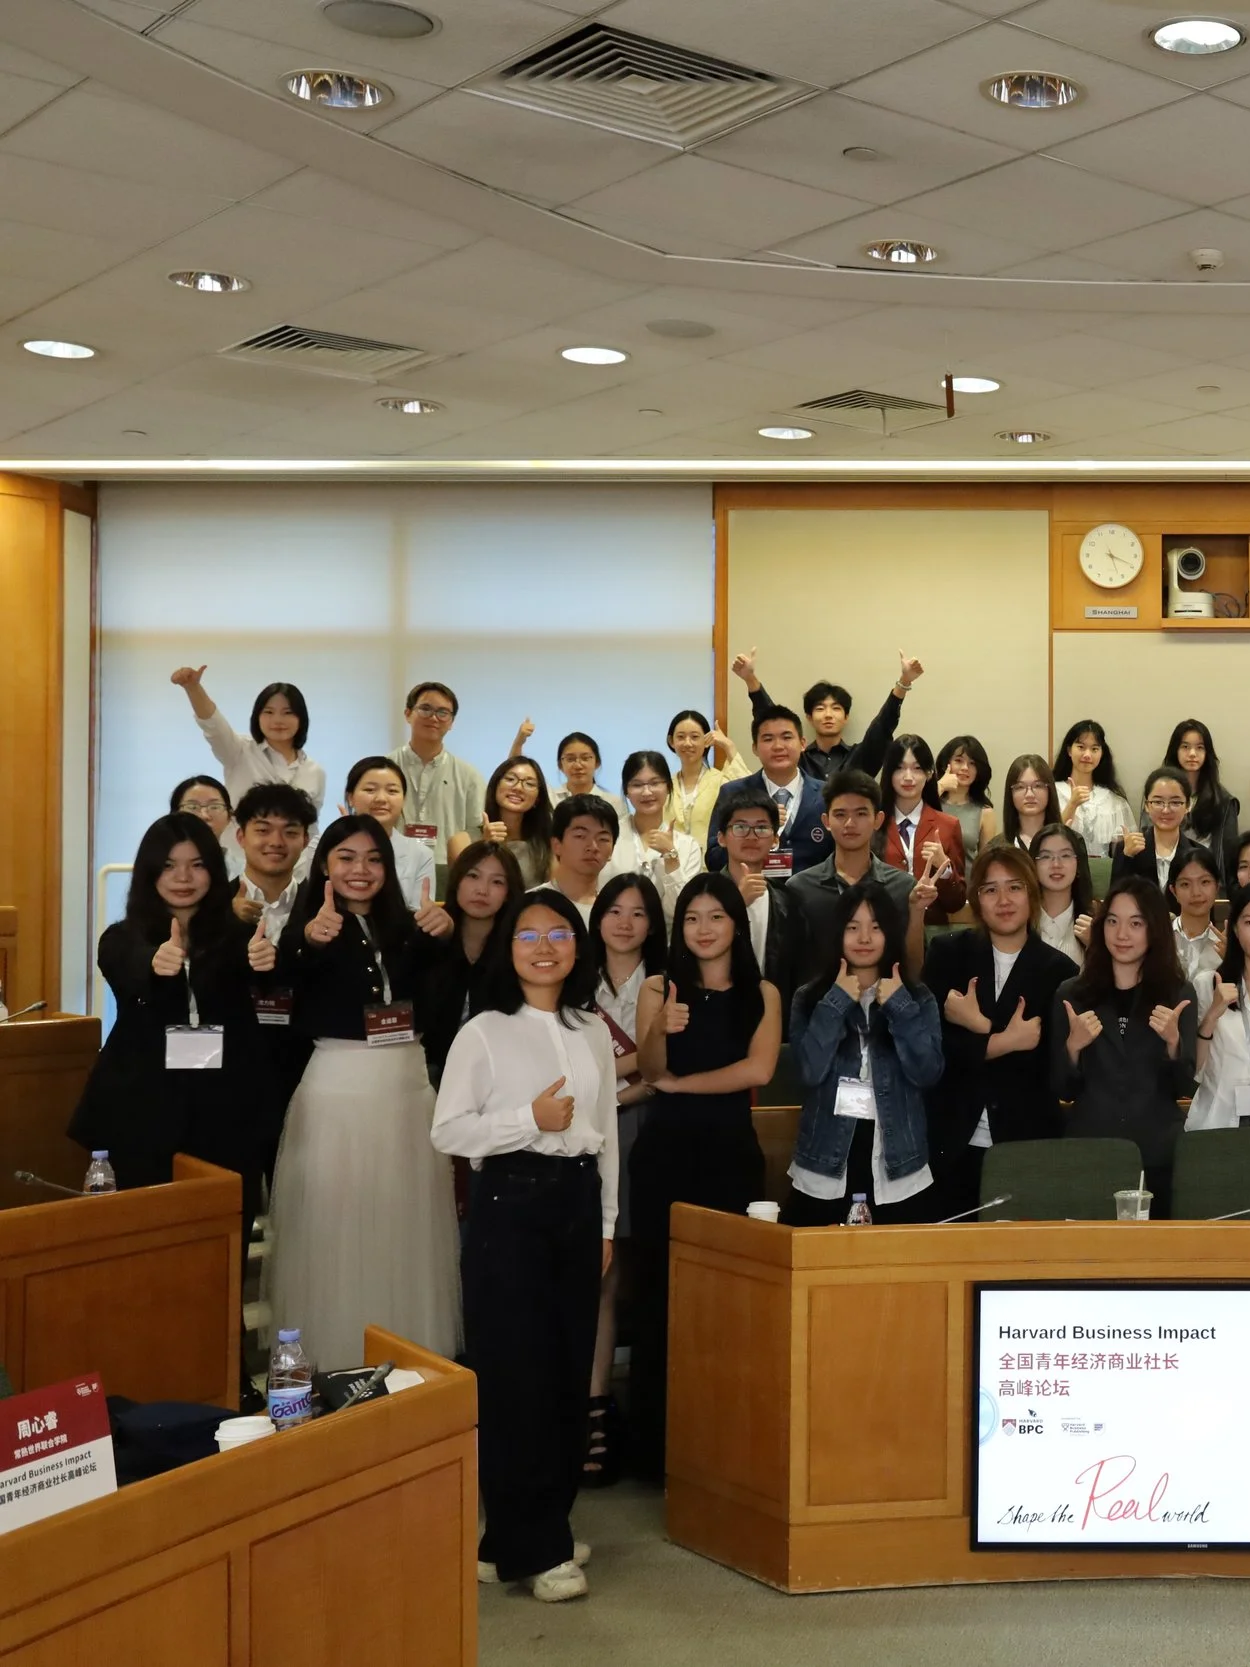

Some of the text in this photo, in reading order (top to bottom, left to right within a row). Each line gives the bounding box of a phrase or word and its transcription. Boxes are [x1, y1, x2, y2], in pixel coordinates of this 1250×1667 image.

[998, 1325, 1216, 1343] Harvard Business Impact
[998, 1352, 1179, 1370] 全国青年经济商业社长
[998, 1379, 1071, 1397] 高峰论坛
[1018, 1424, 1044, 1434] BPC
[0, 1450, 92, 1488] arvard Business Impact
[0, 1462, 98, 1505] 国青年经济商业社长高峰论坛
[1048, 1504, 1075, 1524] the
[1075, 1455, 1169, 1530] Real
[1162, 1501, 1210, 1524] world
